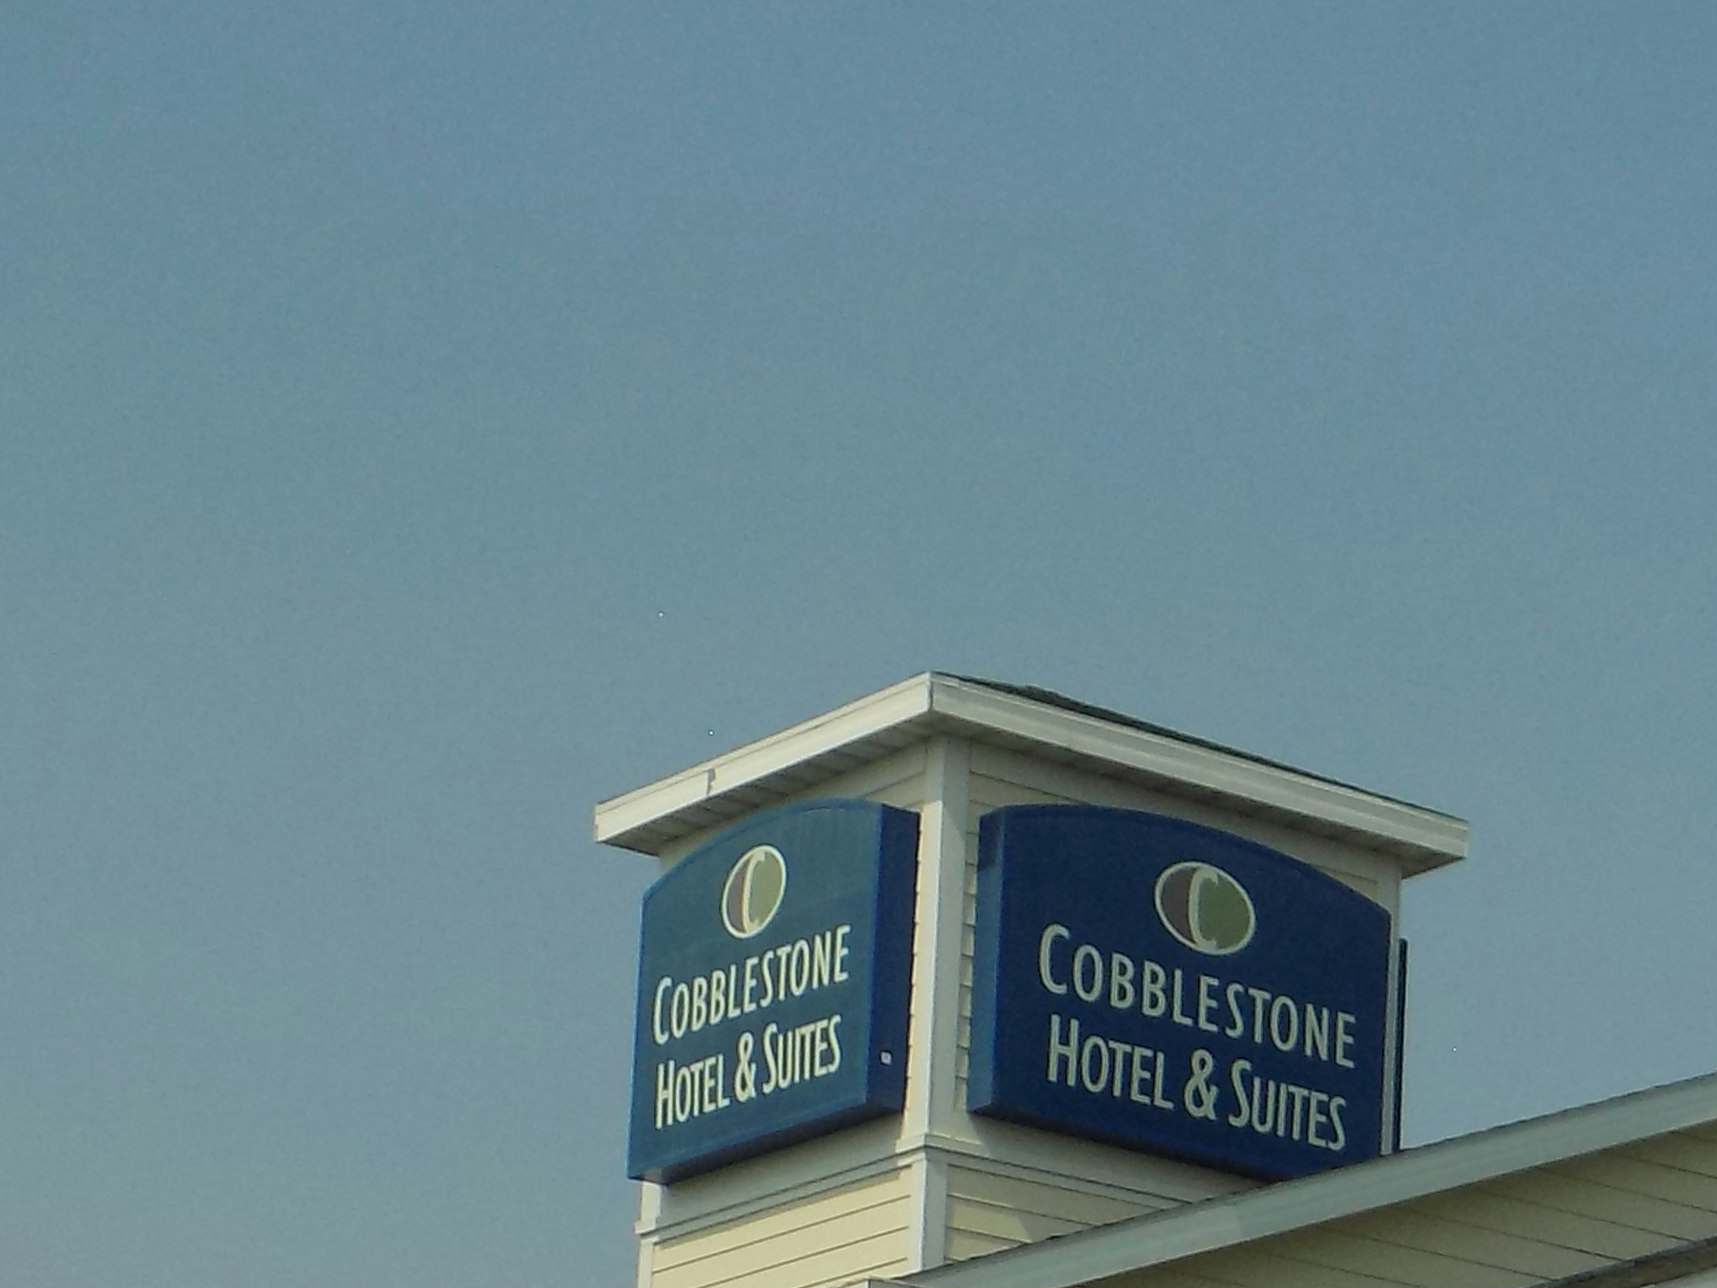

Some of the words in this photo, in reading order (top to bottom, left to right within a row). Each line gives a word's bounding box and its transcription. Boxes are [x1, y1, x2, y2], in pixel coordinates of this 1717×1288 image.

[653, 925, 851, 1045] COBBLESTONE
[1038, 923, 1357, 1069] COBBLESTONE
[655, 1053, 730, 1130] HOTEL
[734, 1032, 757, 1102] &
[762, 1014, 842, 1095] SUITES
[1047, 1013, 1174, 1110] HOTEL
[1183, 1048, 1219, 1121] &
[1228, 1059, 1347, 1152] SUITES
